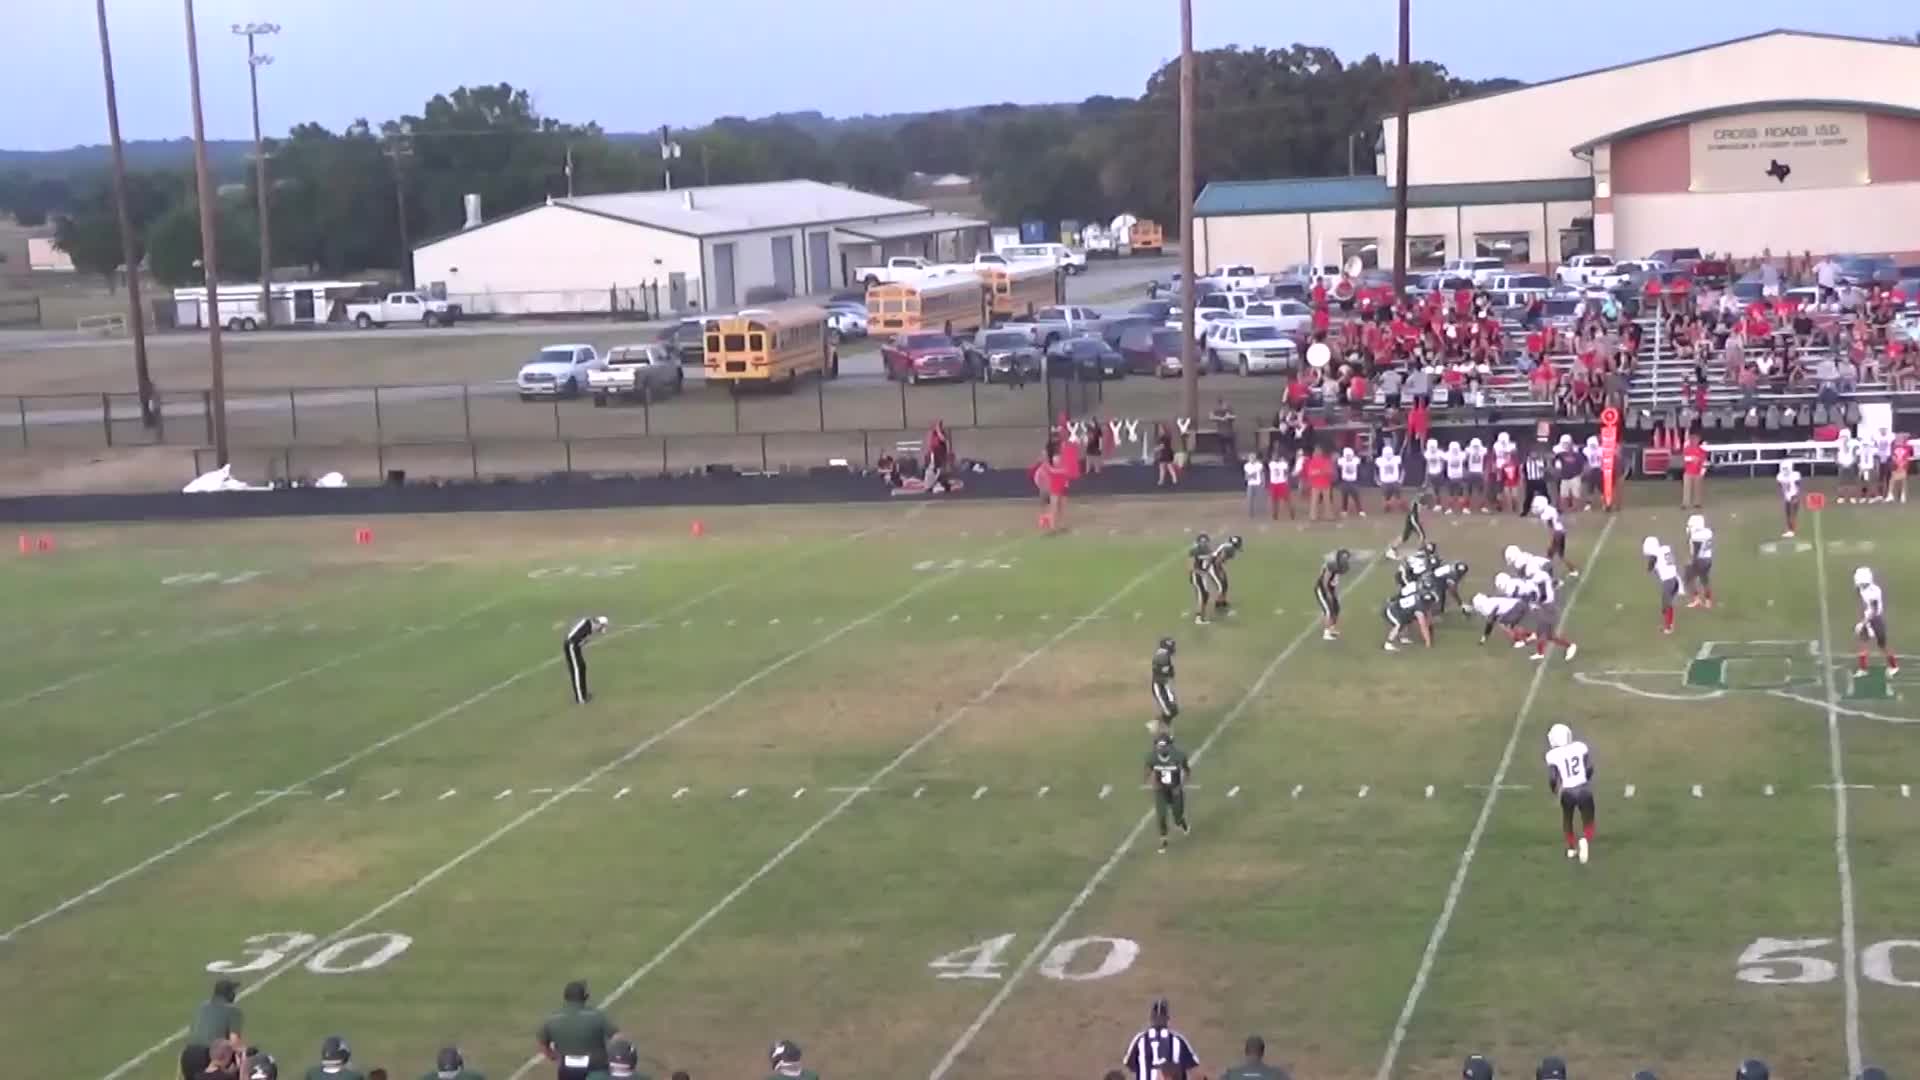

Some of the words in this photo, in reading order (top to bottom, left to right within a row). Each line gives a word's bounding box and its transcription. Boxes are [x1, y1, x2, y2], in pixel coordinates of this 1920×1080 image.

[1764, 125, 1808, 137] ROADS
[1564, 755, 1580, 778] 12
[205, 931, 413, 974] 30
[928, 933, 1141, 981] 40
